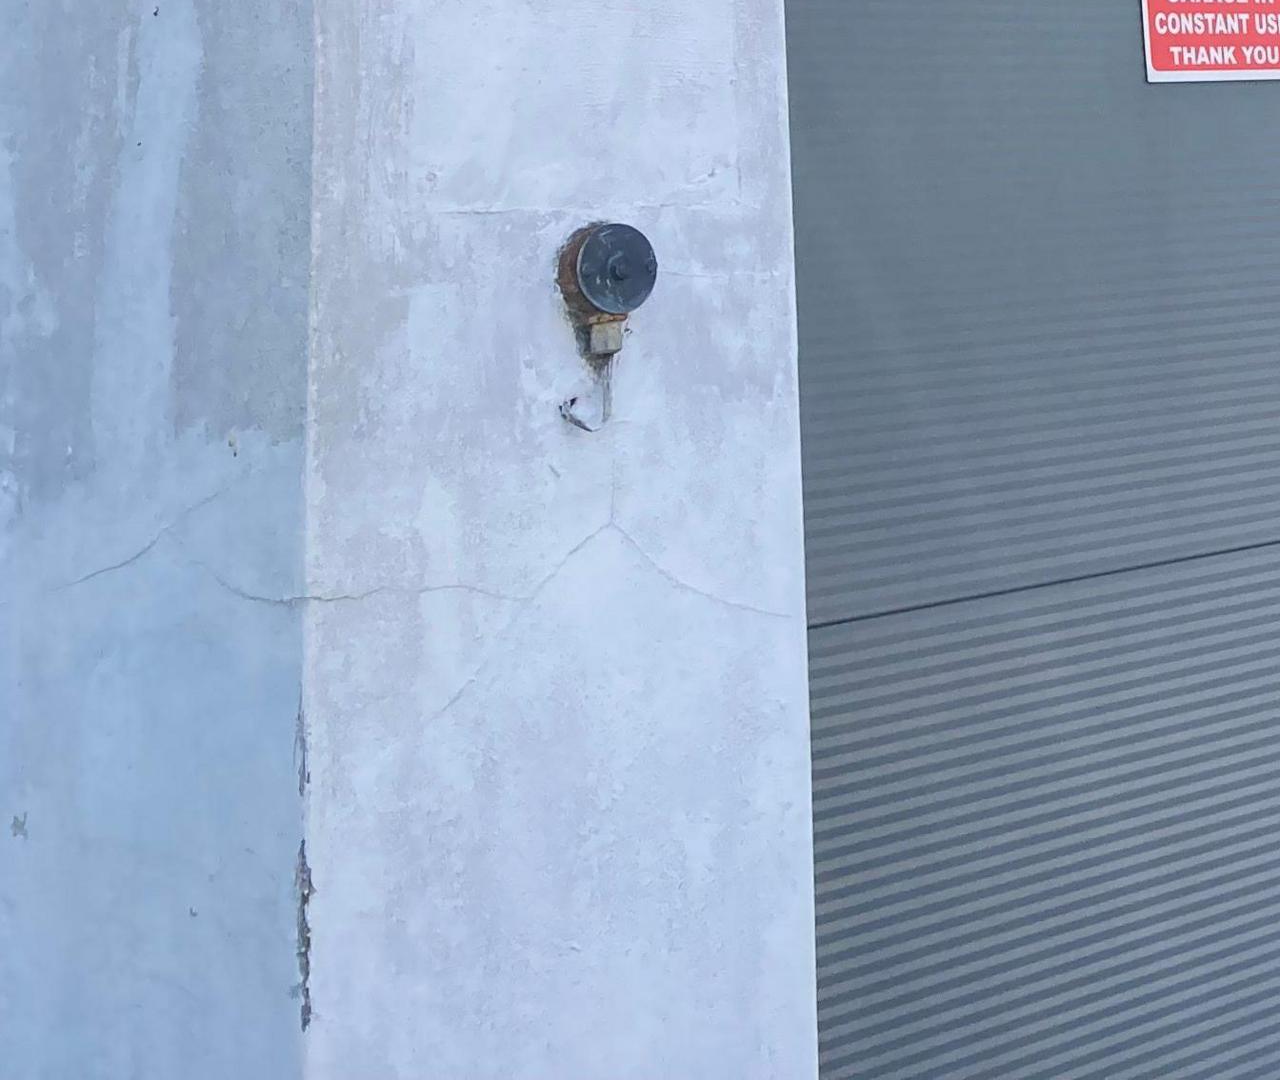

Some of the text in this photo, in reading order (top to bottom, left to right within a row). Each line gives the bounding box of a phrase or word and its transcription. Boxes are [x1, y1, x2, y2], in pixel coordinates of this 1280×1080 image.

[1155, 12, 1250, 35] CONSTANT
[1170, 46, 1280, 65] THANK YOU
